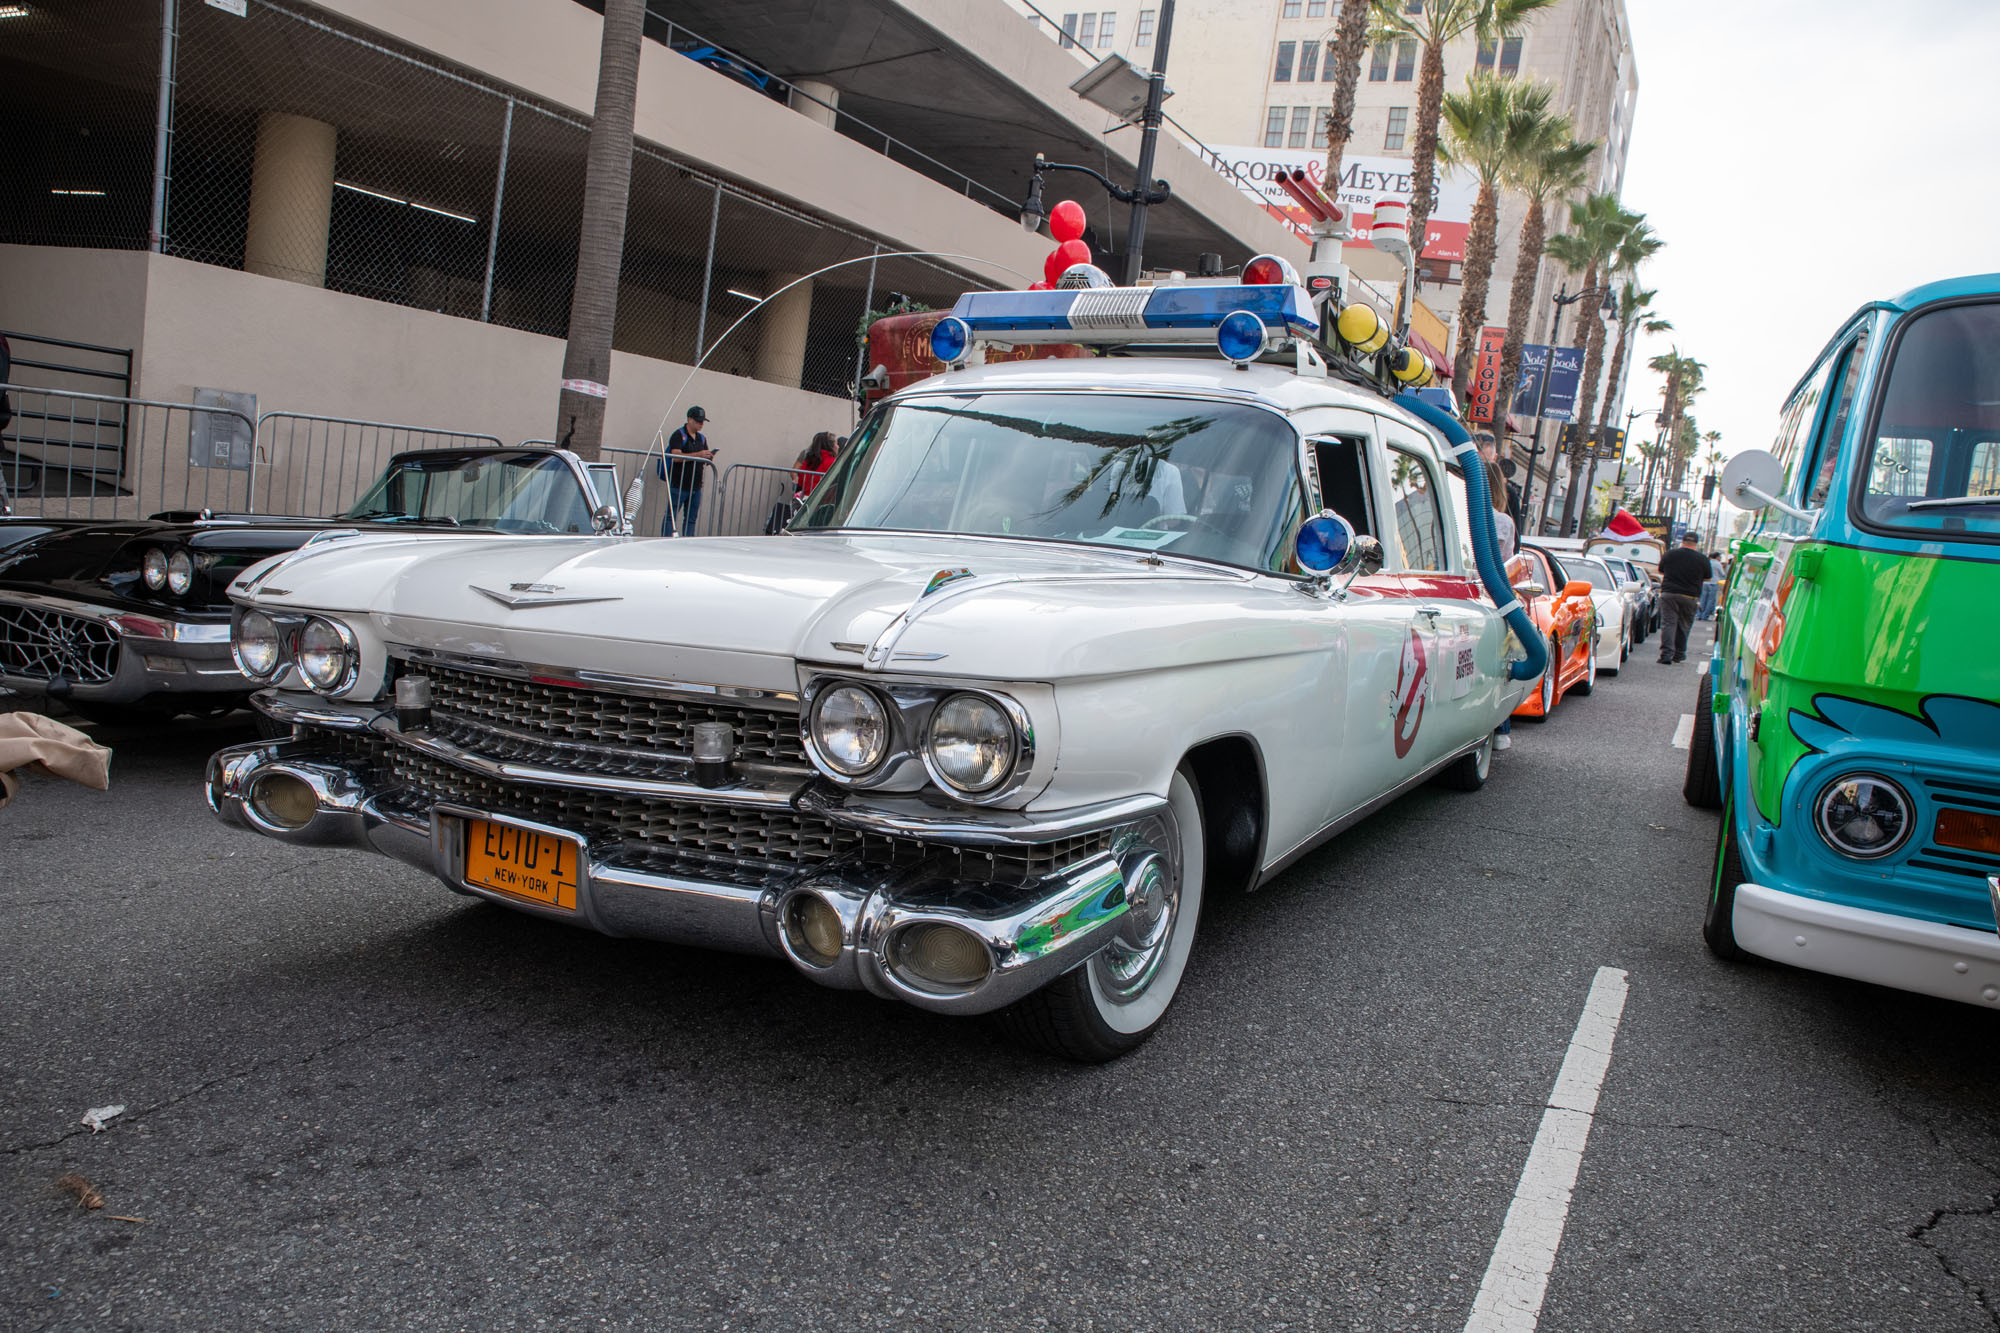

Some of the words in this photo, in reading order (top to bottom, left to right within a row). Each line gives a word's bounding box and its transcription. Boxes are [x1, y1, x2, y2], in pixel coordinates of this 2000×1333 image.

[1306, 160, 1326, 186] &
[1340, 162, 1440, 196] MEYES
[1474, 341, 1499, 418] LIQUOR
[1637, 516, 1662, 525] NAMA
[1456, 661, 1474, 680] BUSTERS
[495, 867, 517, 885] NEW
[521, 875, 549, 895] YORK
